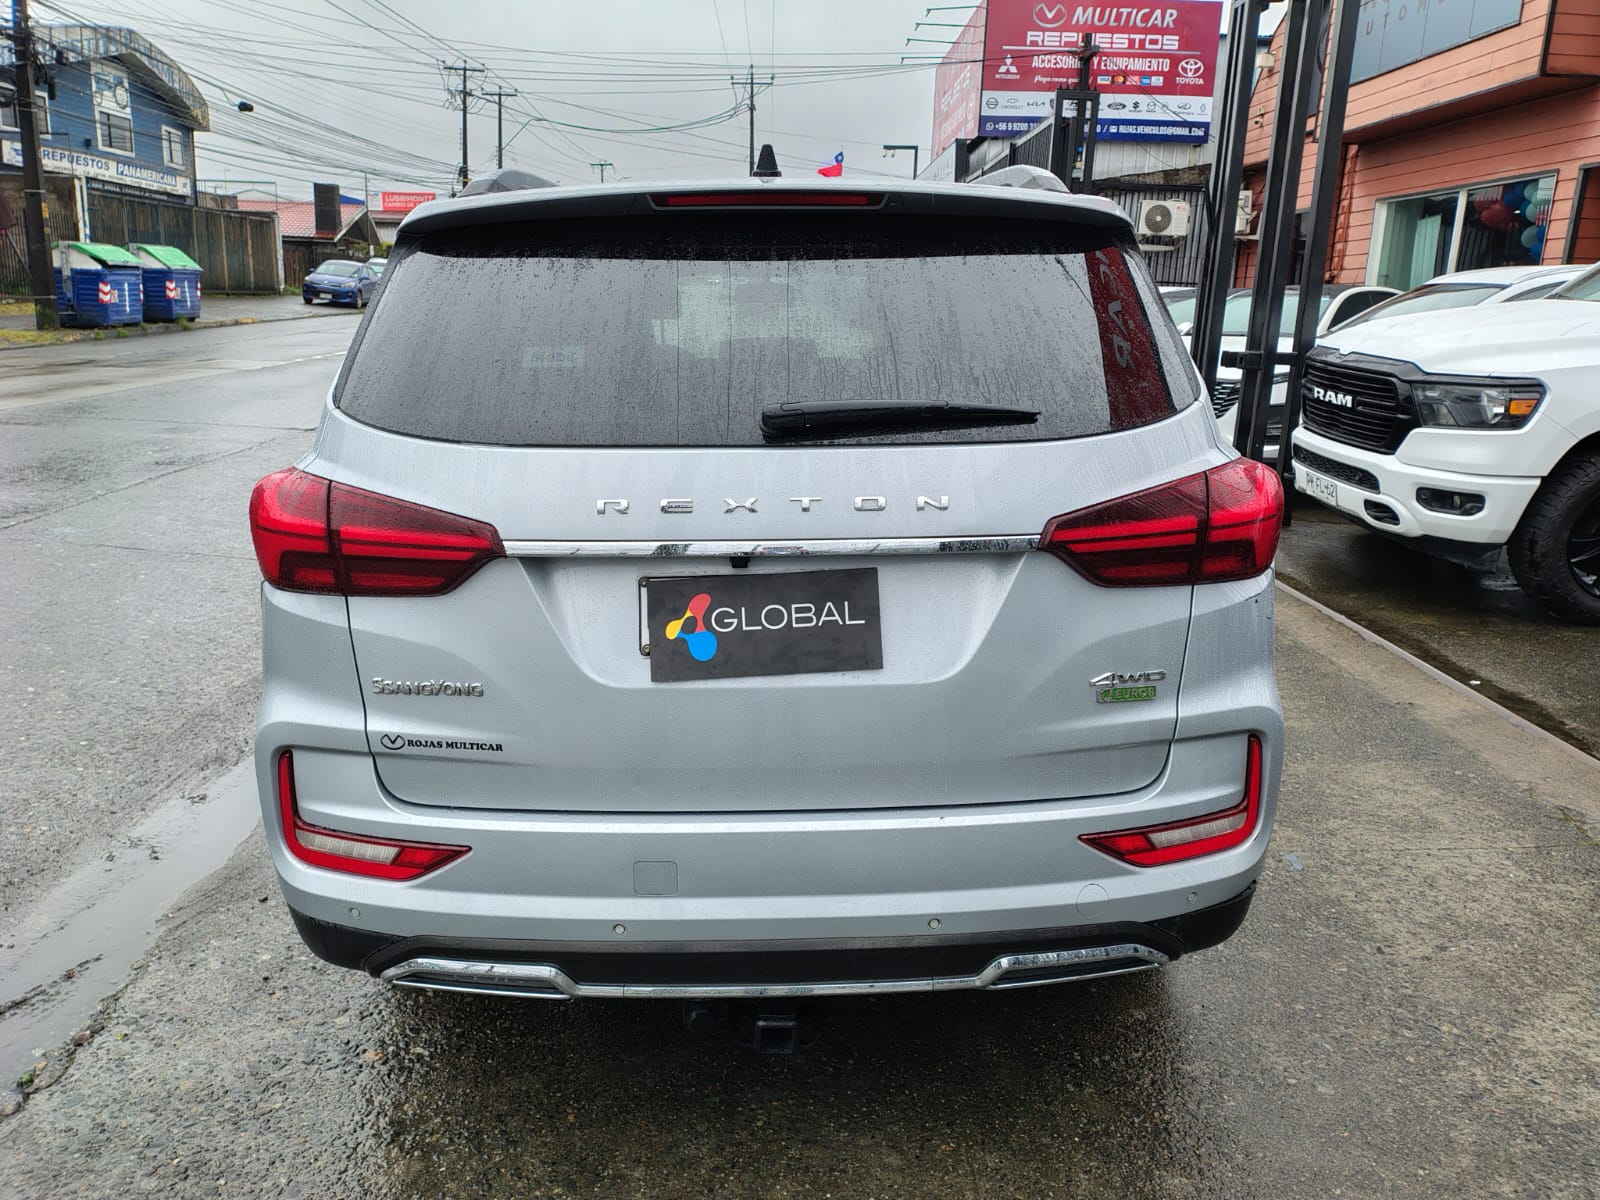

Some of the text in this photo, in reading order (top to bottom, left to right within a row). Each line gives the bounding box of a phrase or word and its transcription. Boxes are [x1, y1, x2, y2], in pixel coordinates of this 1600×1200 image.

[1071, 6, 1178, 28] MULTICAR
[1092, 56, 1099, 69] Y
[1101, 57, 1170, 72] EQUIPAMIENTO
[1176, 77, 1204, 85] TOYOTA
[42, 149, 110, 171] REPUESTOS
[117, 163, 177, 186] PANAMERICANA
[1313, 386, 1352, 408] RAM
[597, 495, 949, 514] REXTON
[711, 601, 865, 632] GLOBAL
[1089, 669, 1166, 687] 4WD
[407, 739, 504, 752] ROJAS MULTICAR
